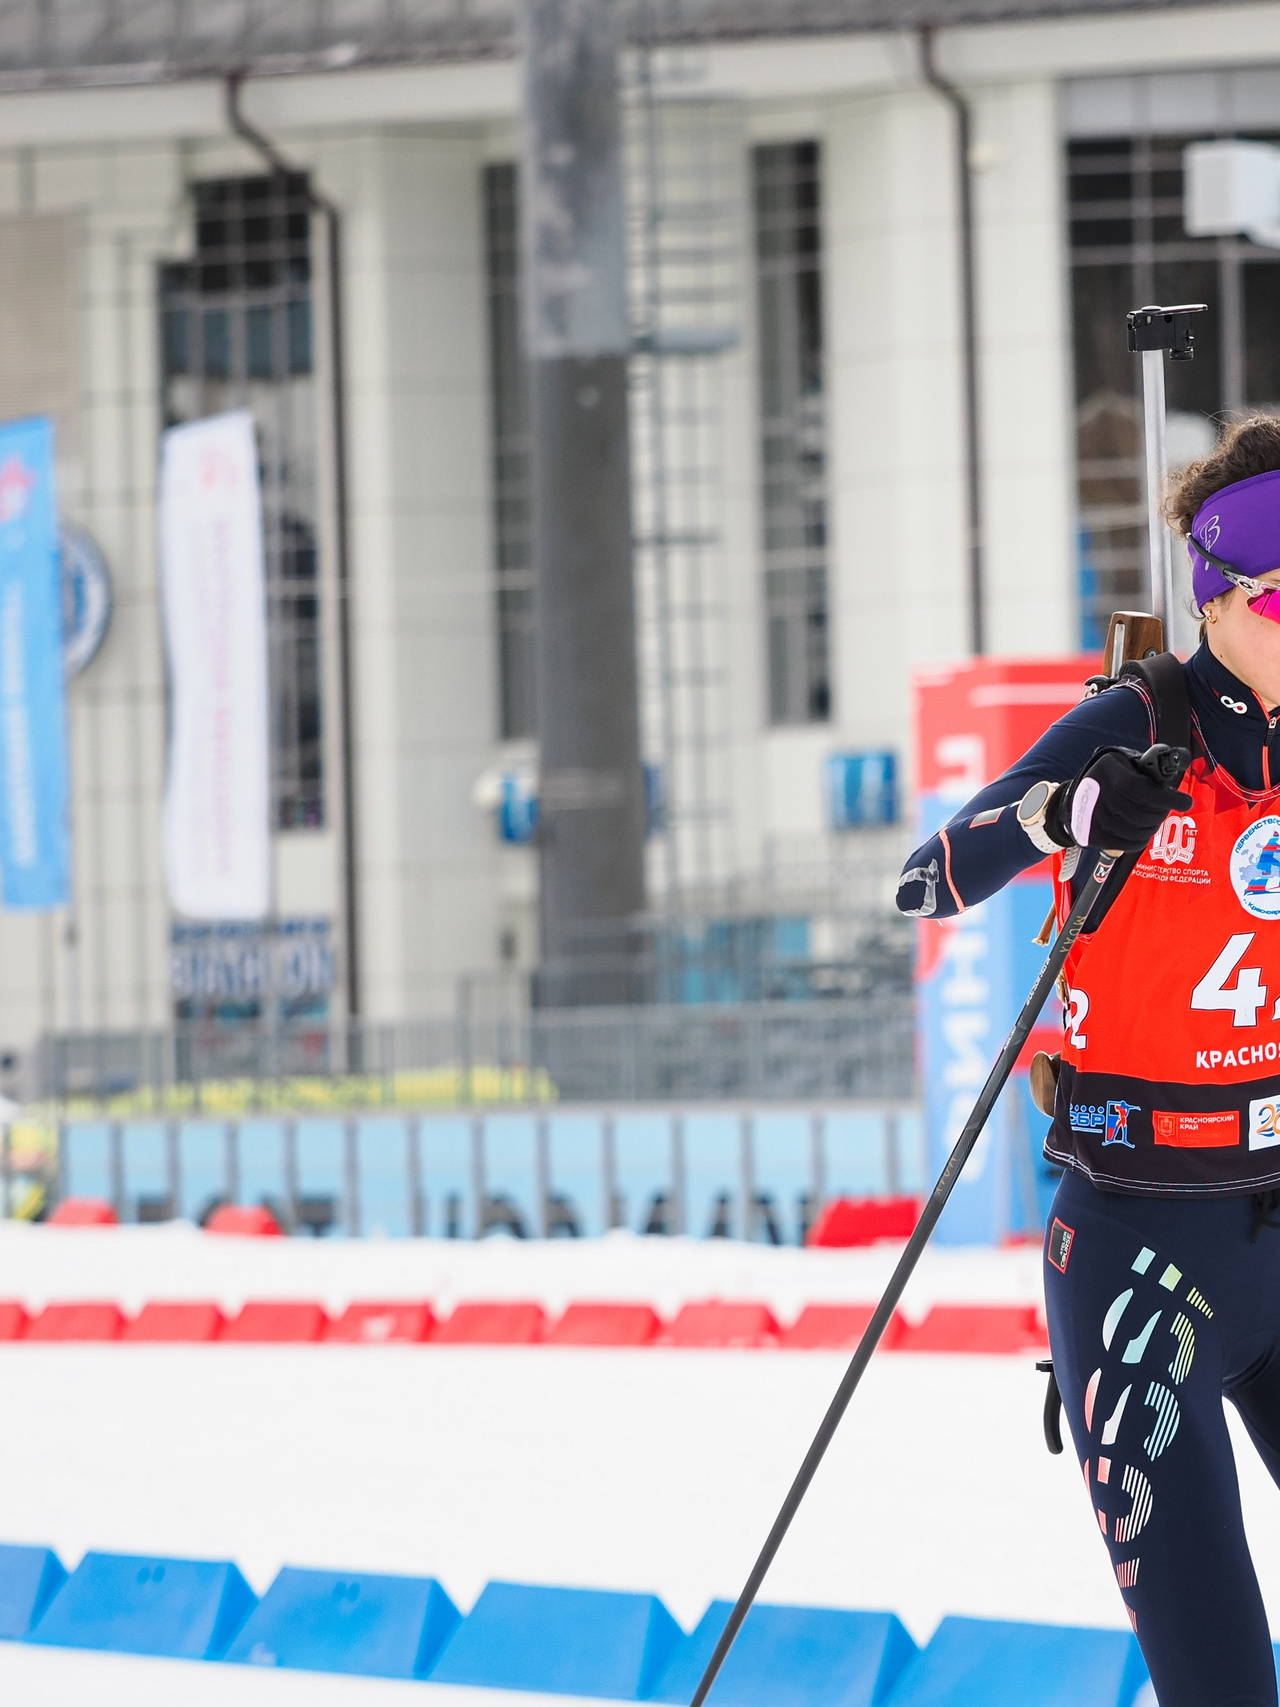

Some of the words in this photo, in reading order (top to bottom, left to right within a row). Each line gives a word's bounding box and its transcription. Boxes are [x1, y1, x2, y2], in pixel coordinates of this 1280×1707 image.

[1182, 868, 1208, 876] СПОРТА
[1169, 874, 1212, 885] ФЕДЕРАЦИИ
[1180, 1115, 1235, 1124] КРАСНОЯРСКИЙ
[1180, 1123, 1199, 1131] КРАЙ
